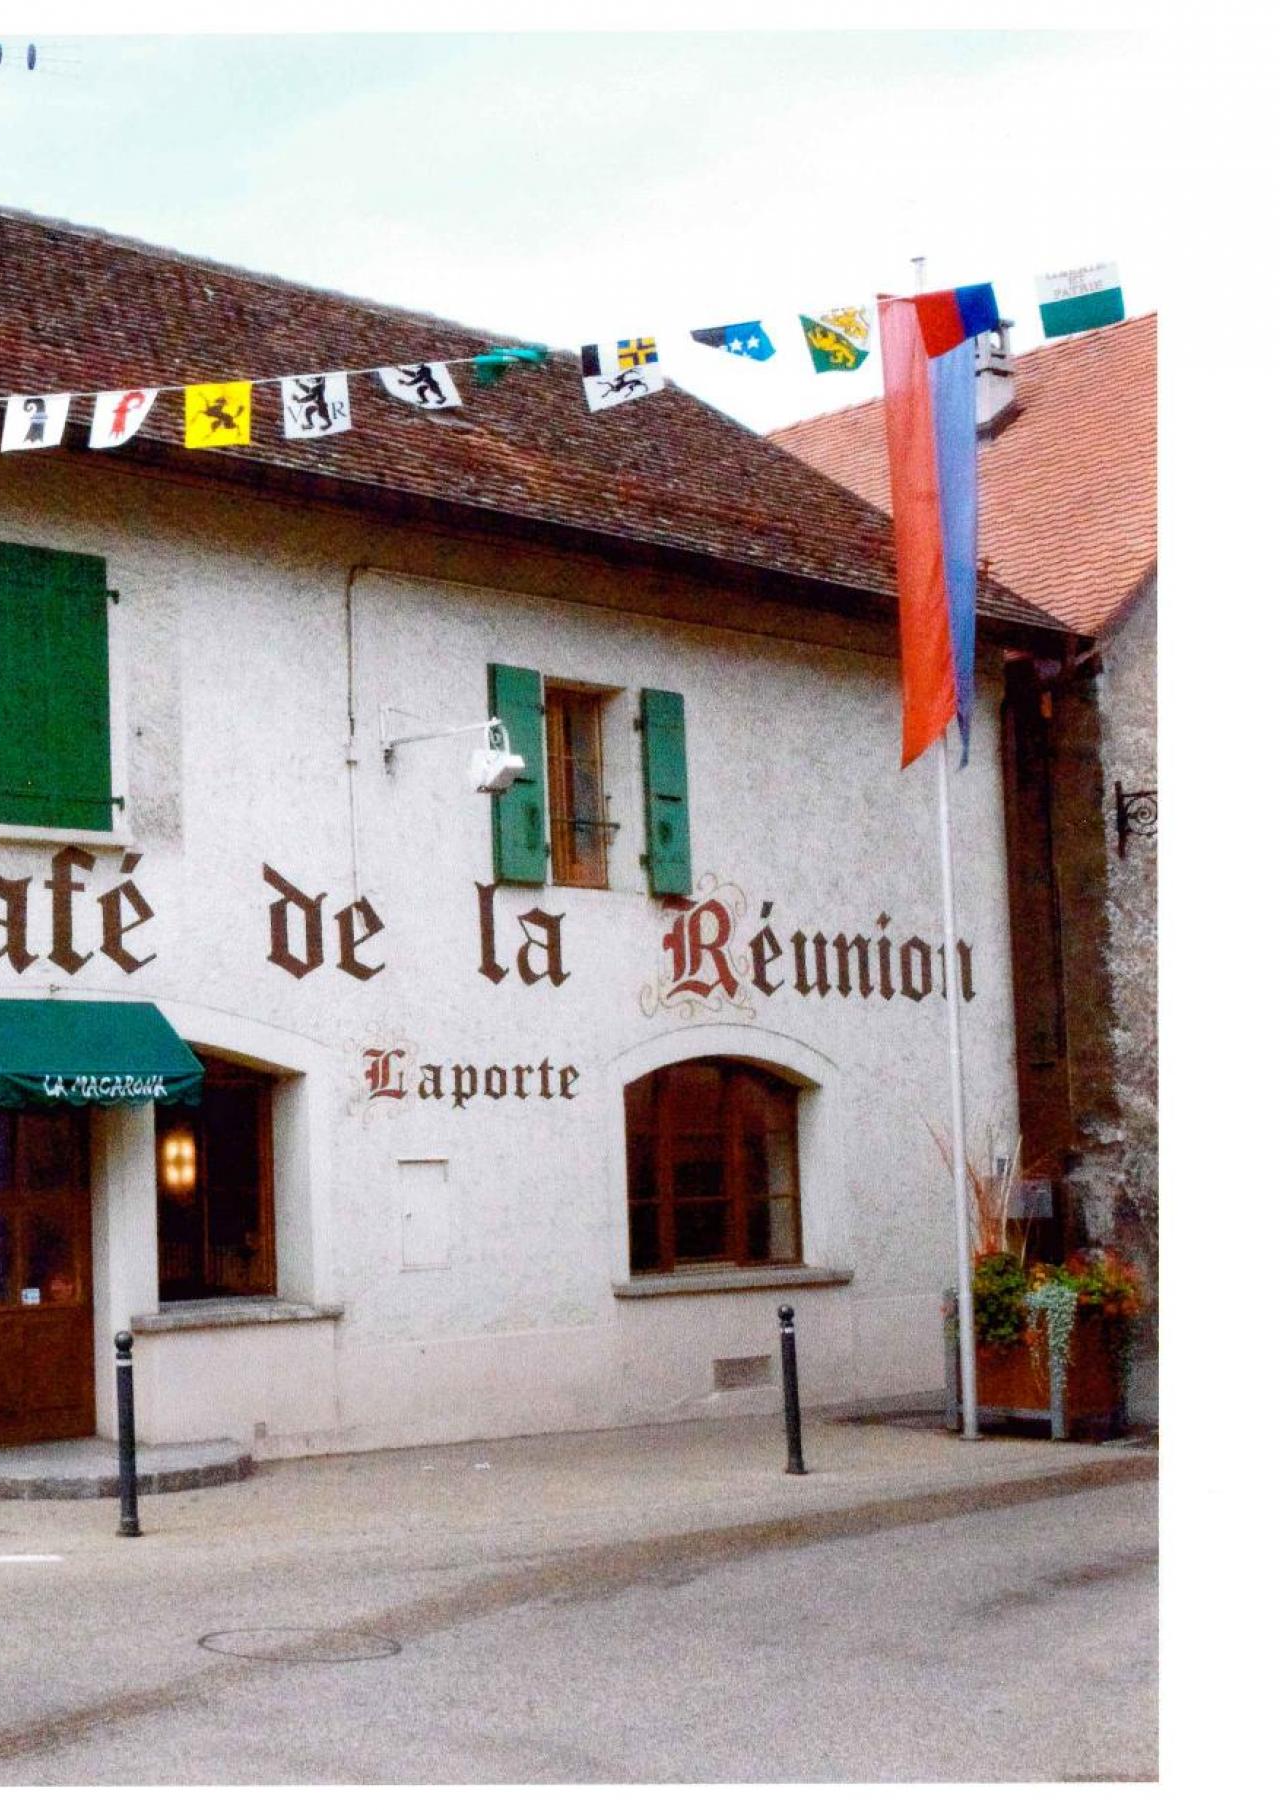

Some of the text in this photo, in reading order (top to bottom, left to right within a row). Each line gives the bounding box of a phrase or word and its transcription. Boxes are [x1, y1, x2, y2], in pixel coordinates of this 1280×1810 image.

[261, 863, 386, 981] de
[475, 881, 570, 988] la
[662, 896, 977, 1002] Réunion
[42, 1074, 69, 1098] LA
[363, 1048, 580, 1110] Laporte
